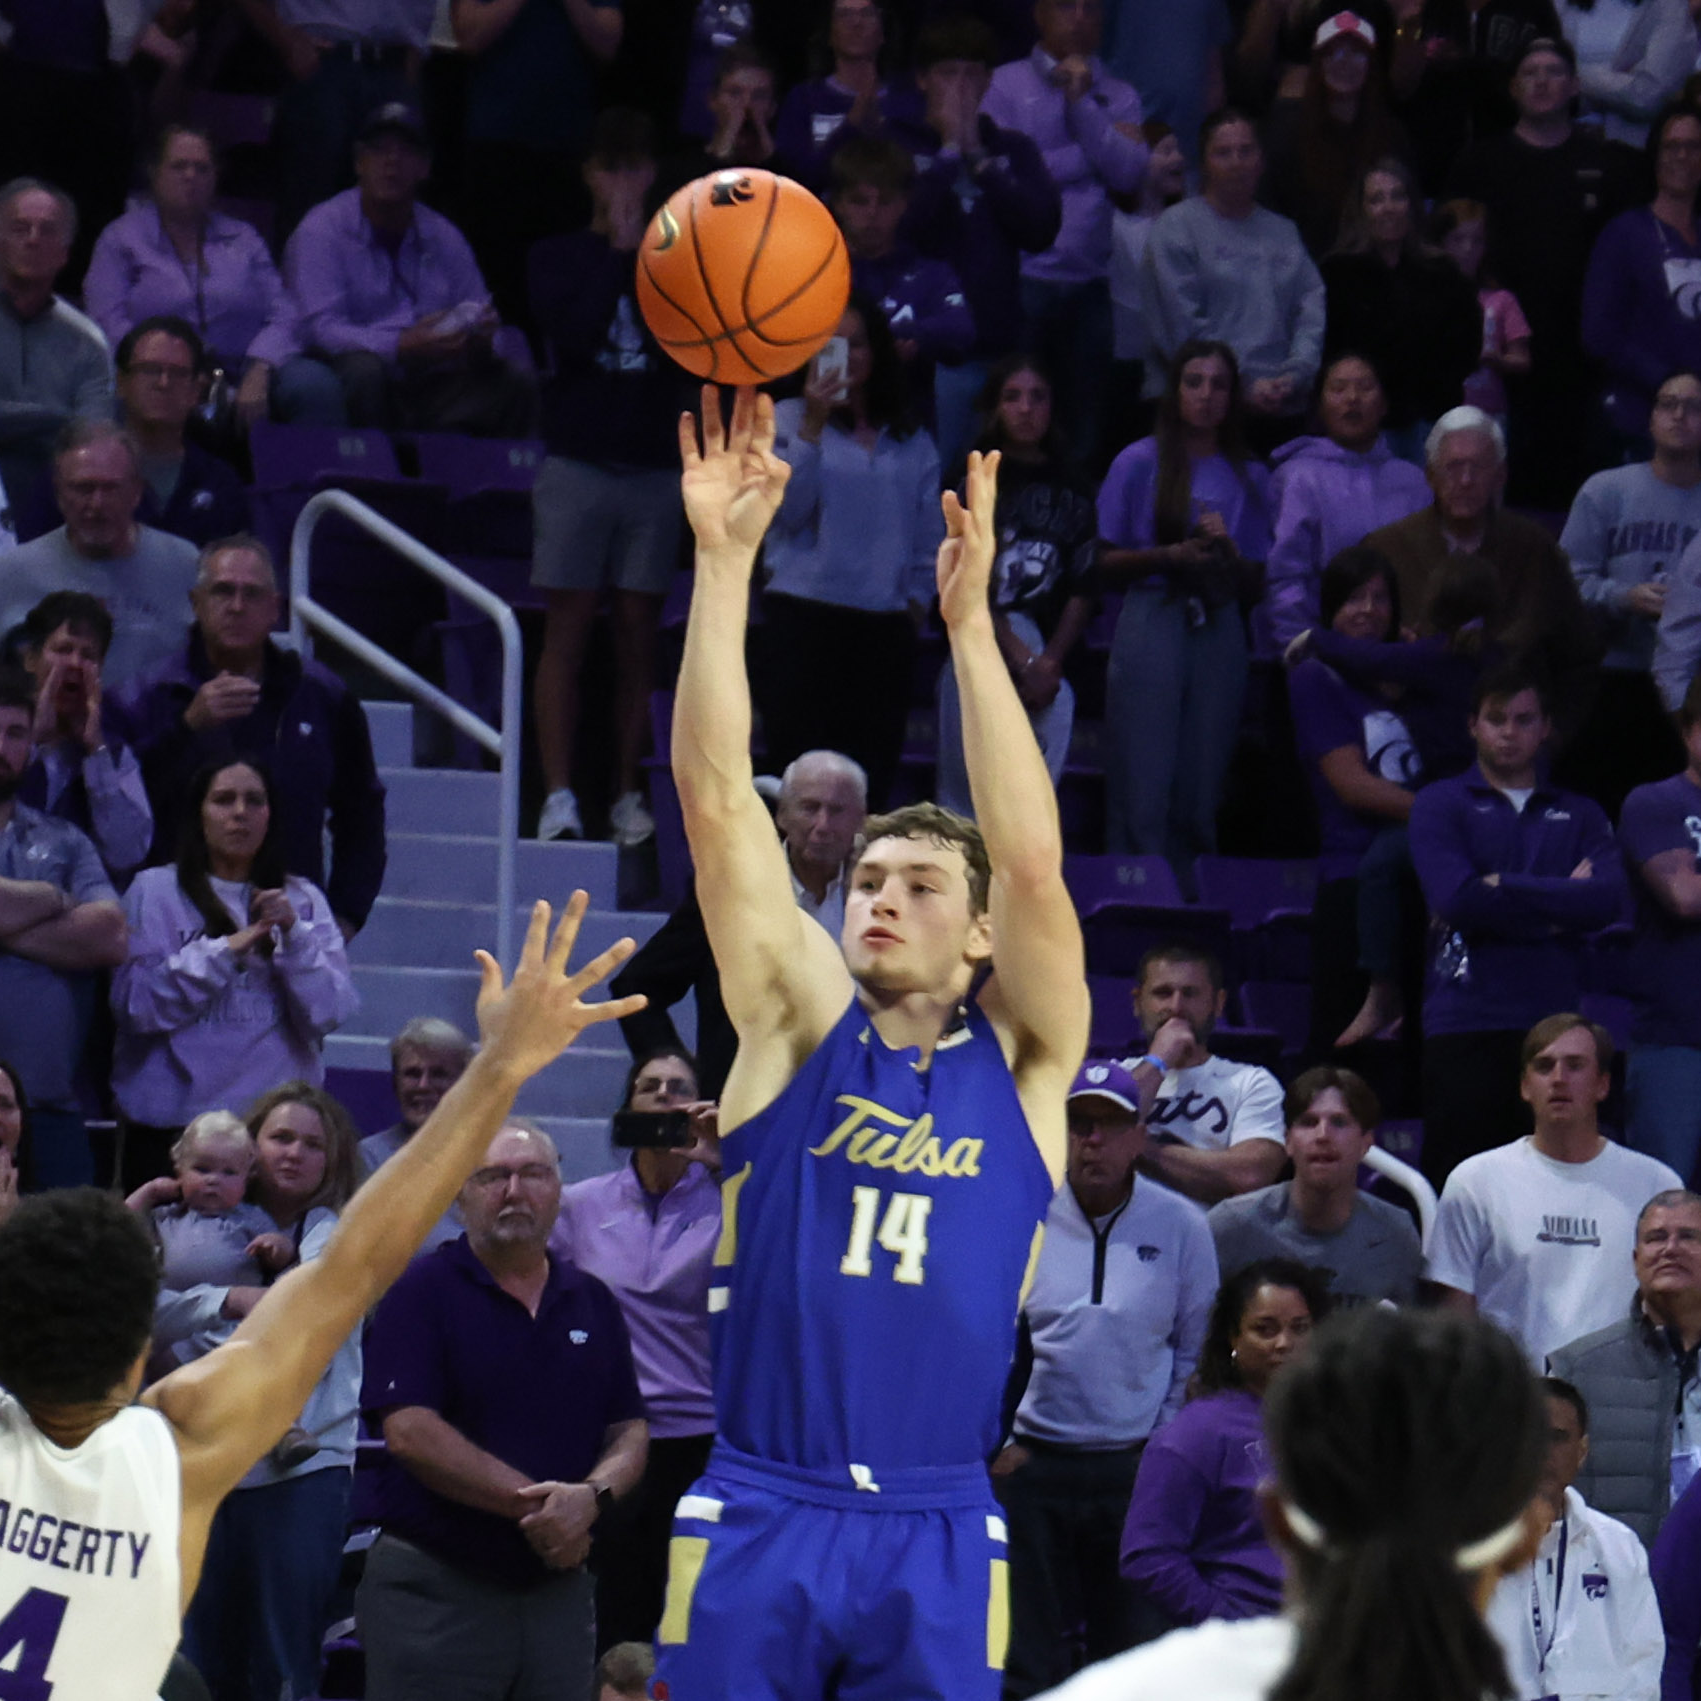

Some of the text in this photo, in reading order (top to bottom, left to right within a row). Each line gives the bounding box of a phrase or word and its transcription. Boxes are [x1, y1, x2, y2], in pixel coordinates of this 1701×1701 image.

[809, 1094, 983, 1178] Tulsa
[1146, 1090, 1229, 1134] ats
[839, 1185, 932, 1286] 14
